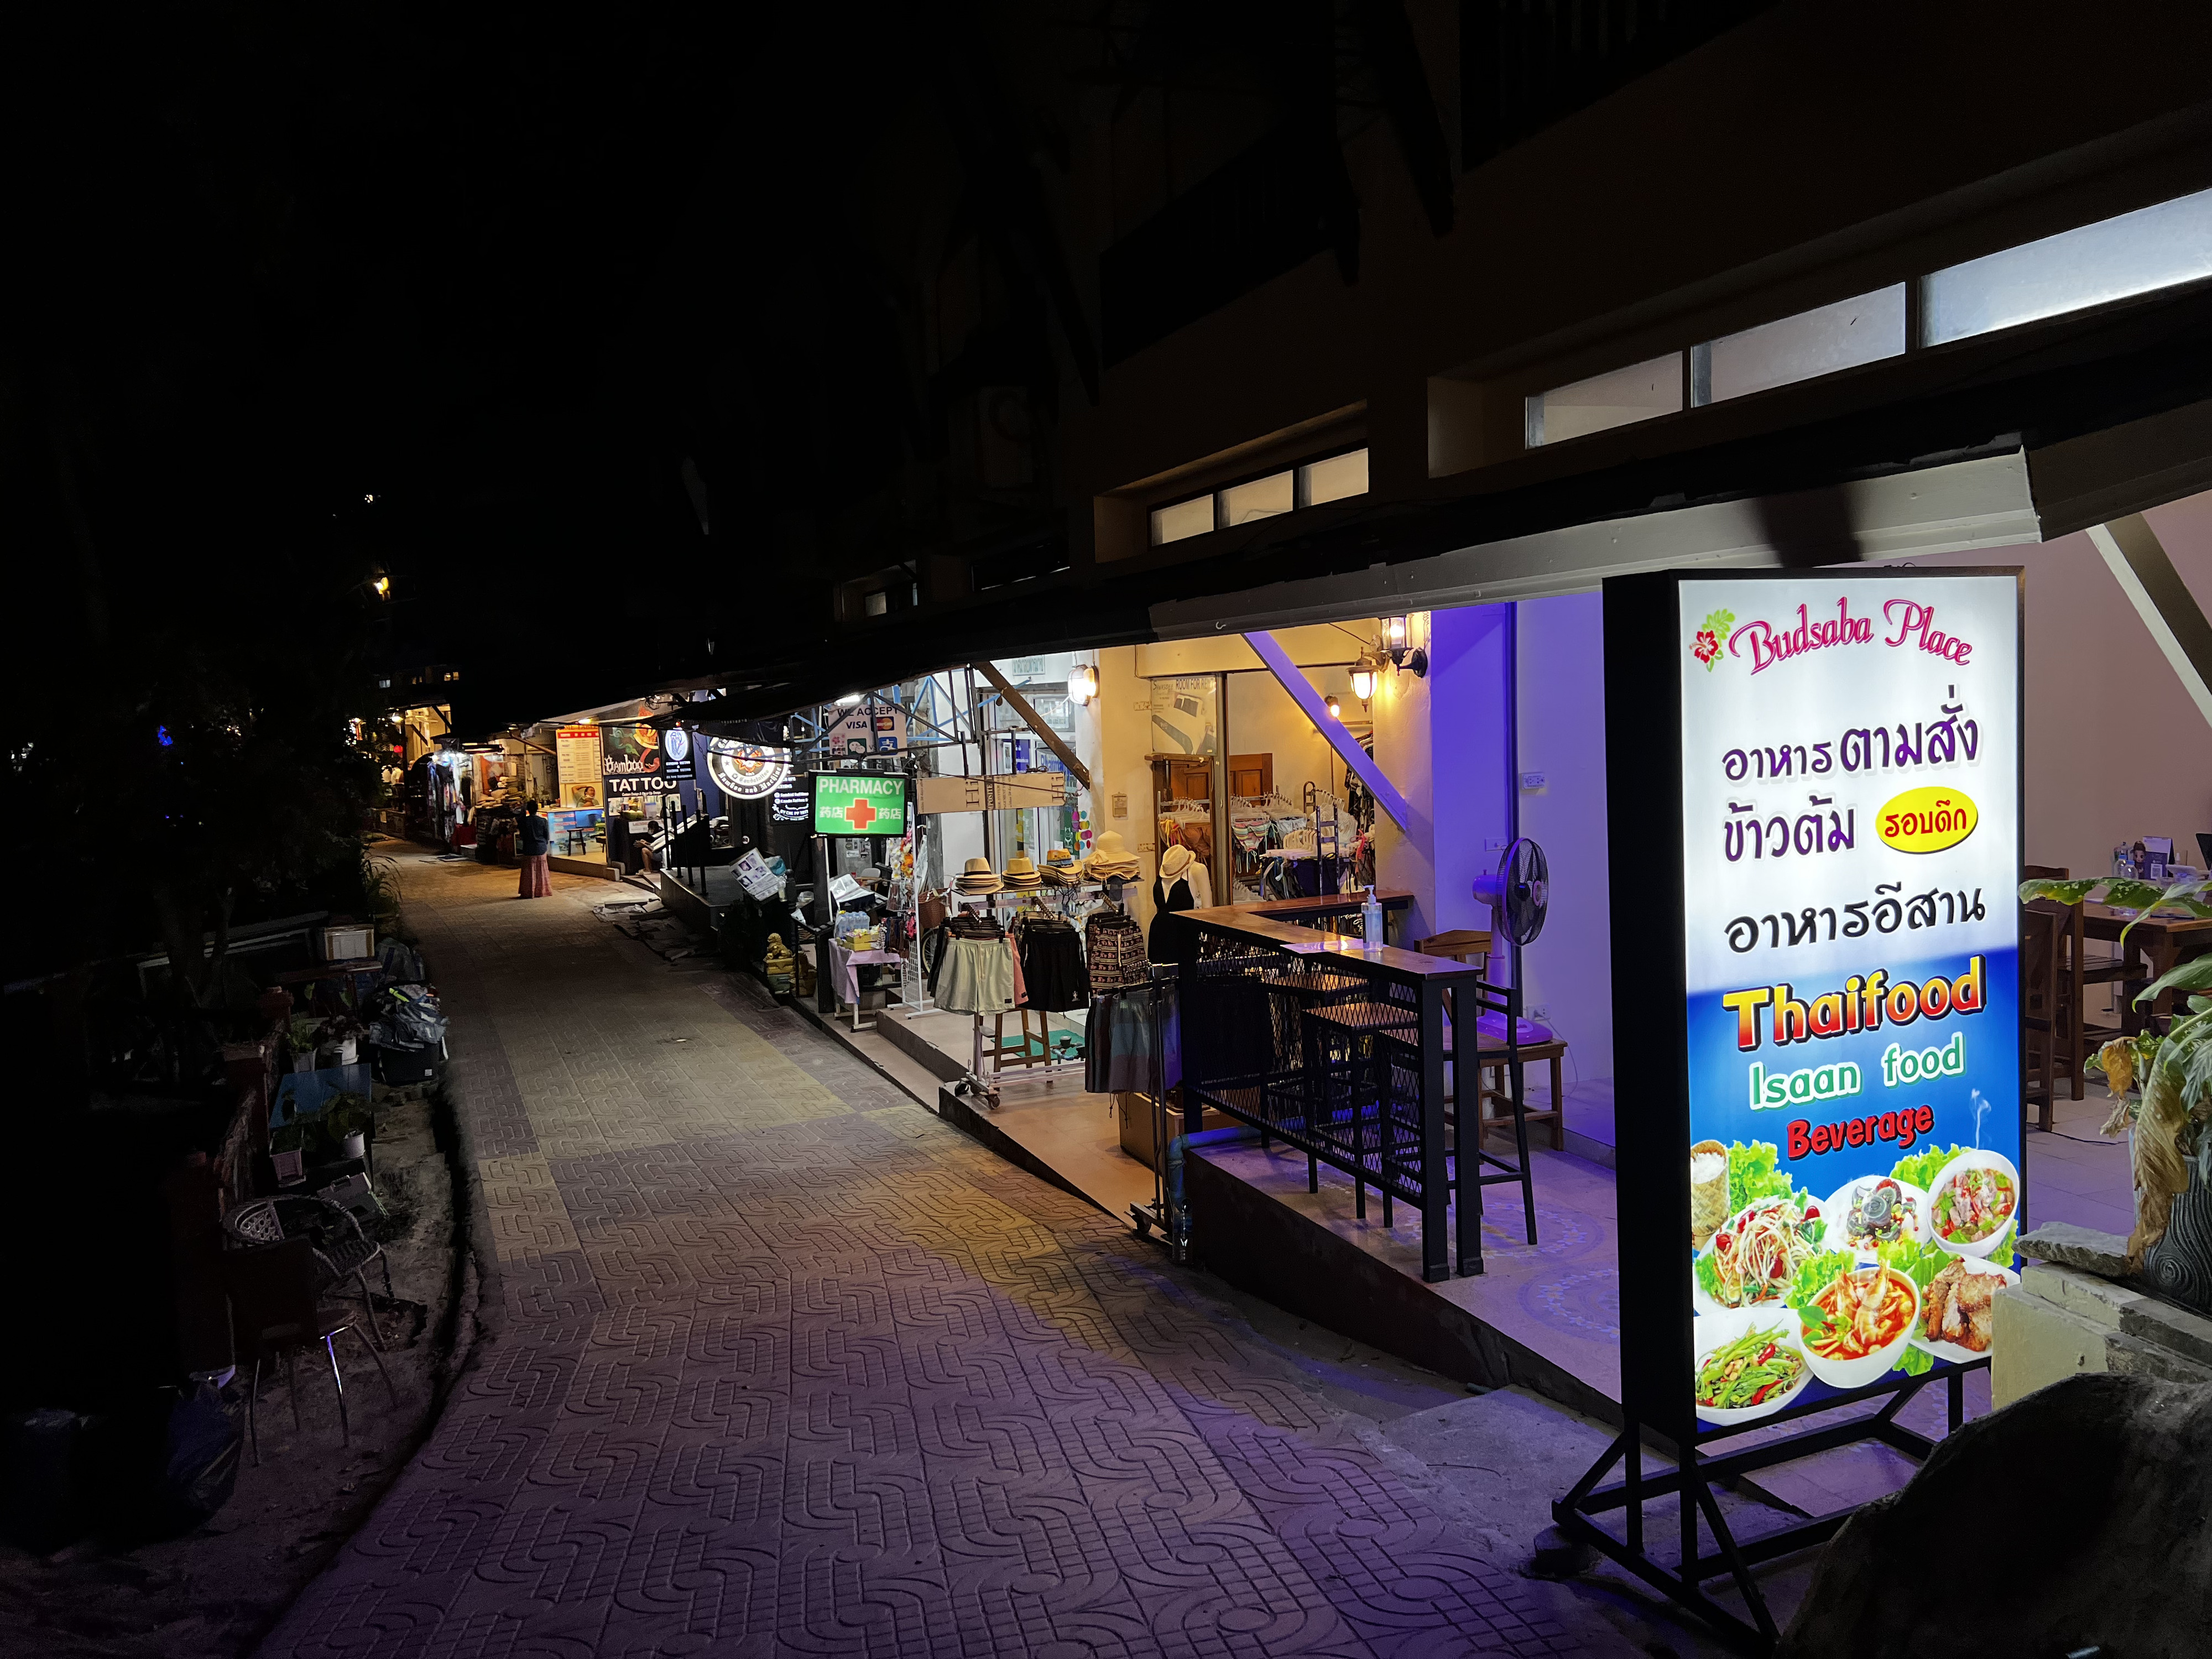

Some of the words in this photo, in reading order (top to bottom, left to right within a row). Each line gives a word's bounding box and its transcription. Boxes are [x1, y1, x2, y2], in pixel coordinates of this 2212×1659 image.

[1729, 596, 1874, 676] Budsaba
[1883, 598, 1973, 666] Place
[1176, 679, 1191, 690] ROOM
[1191, 679, 1200, 690] FOR
[846, 721, 868, 729] VISA
[609, 776, 677, 792] TATTOO
[819, 778, 903, 795] PHARMACY
[819, 806, 844, 819] 药店
[878, 807, 902, 820] 药店
[1724, 796, 1855, 863] ข้าวต้ม
[1884, 800, 1967, 838] รอบดึก
[1724, 881, 1985, 953] อาหารอีสาน
[1722, 954, 1987, 1052] Thaifood
[1750, 1061, 1863, 1113] Isaan
[1880, 1031, 1966, 1088] food
[1787, 1104, 1935, 1160] Beverage
